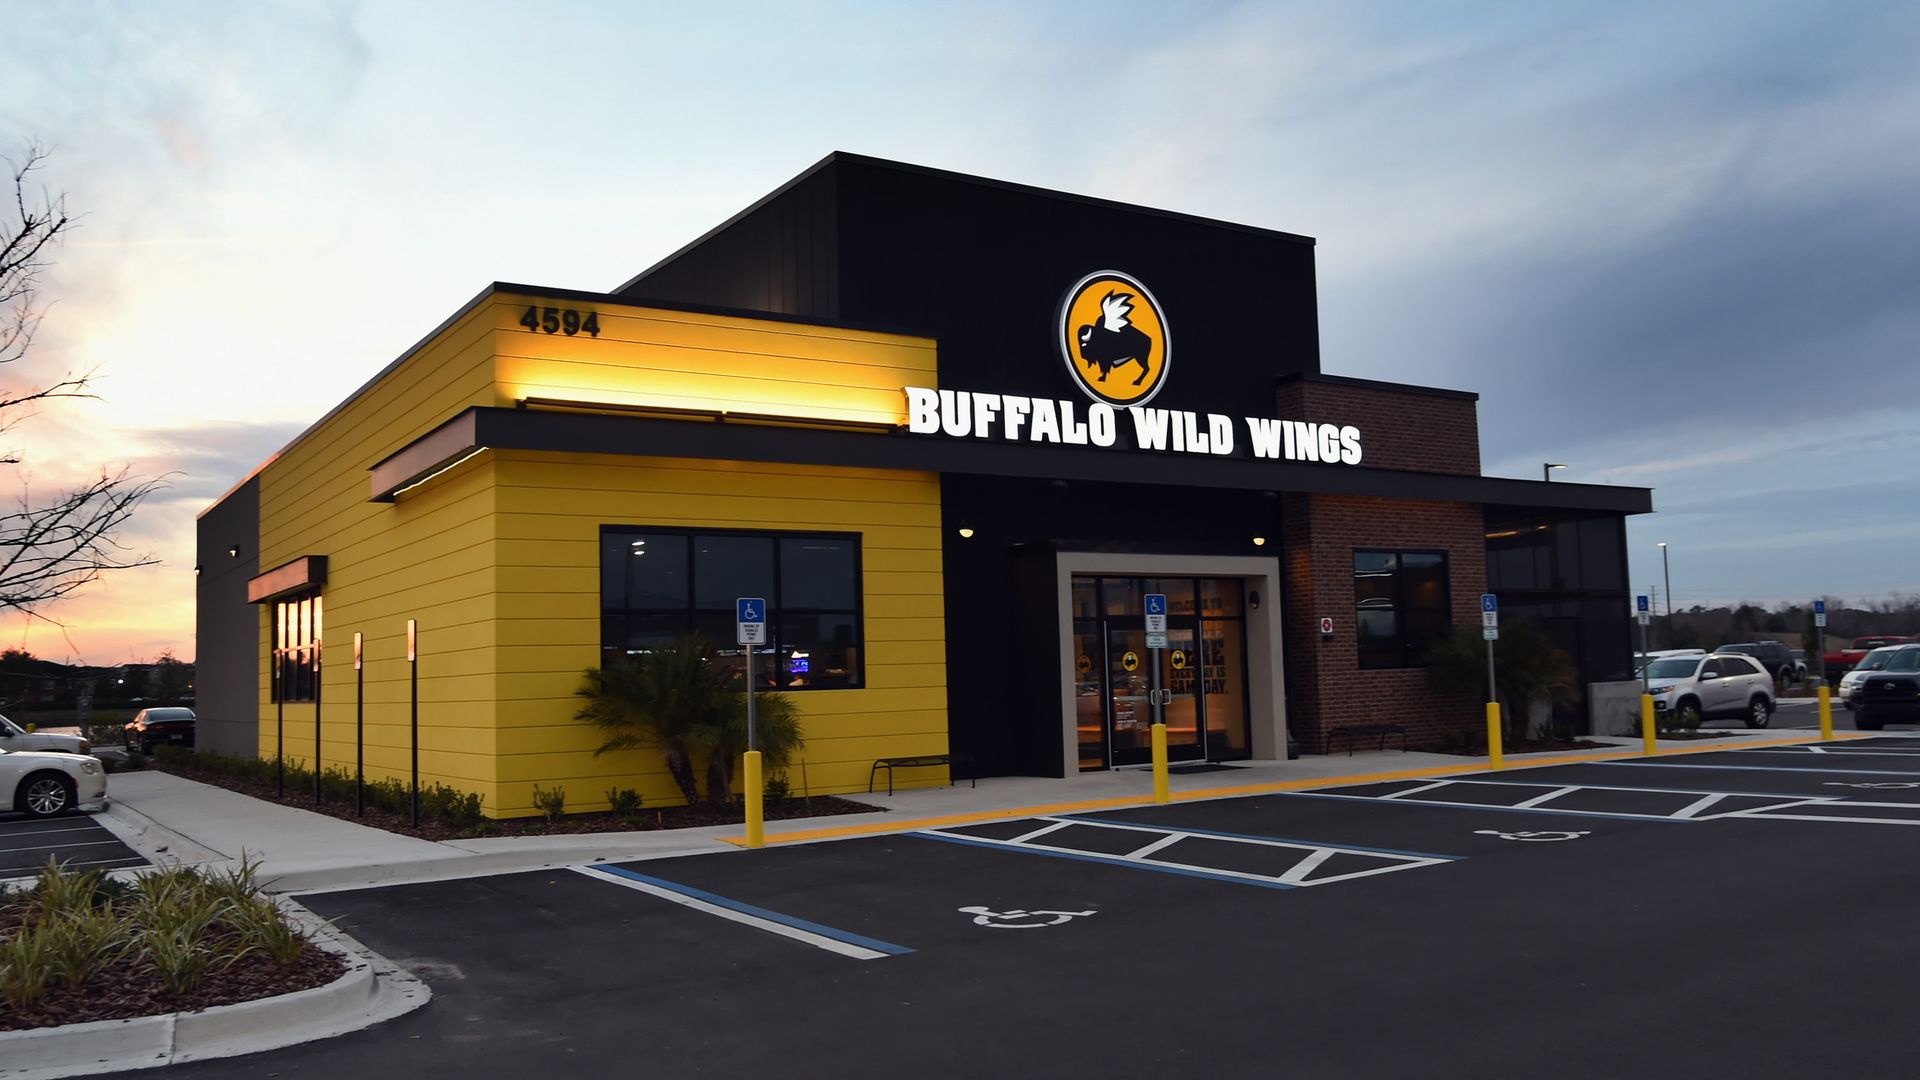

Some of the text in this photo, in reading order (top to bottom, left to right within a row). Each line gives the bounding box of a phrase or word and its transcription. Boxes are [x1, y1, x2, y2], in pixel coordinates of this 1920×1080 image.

[520, 306, 600, 337] 4594
[905, 387, 1362, 465] BUFFALO WILD WINGS
